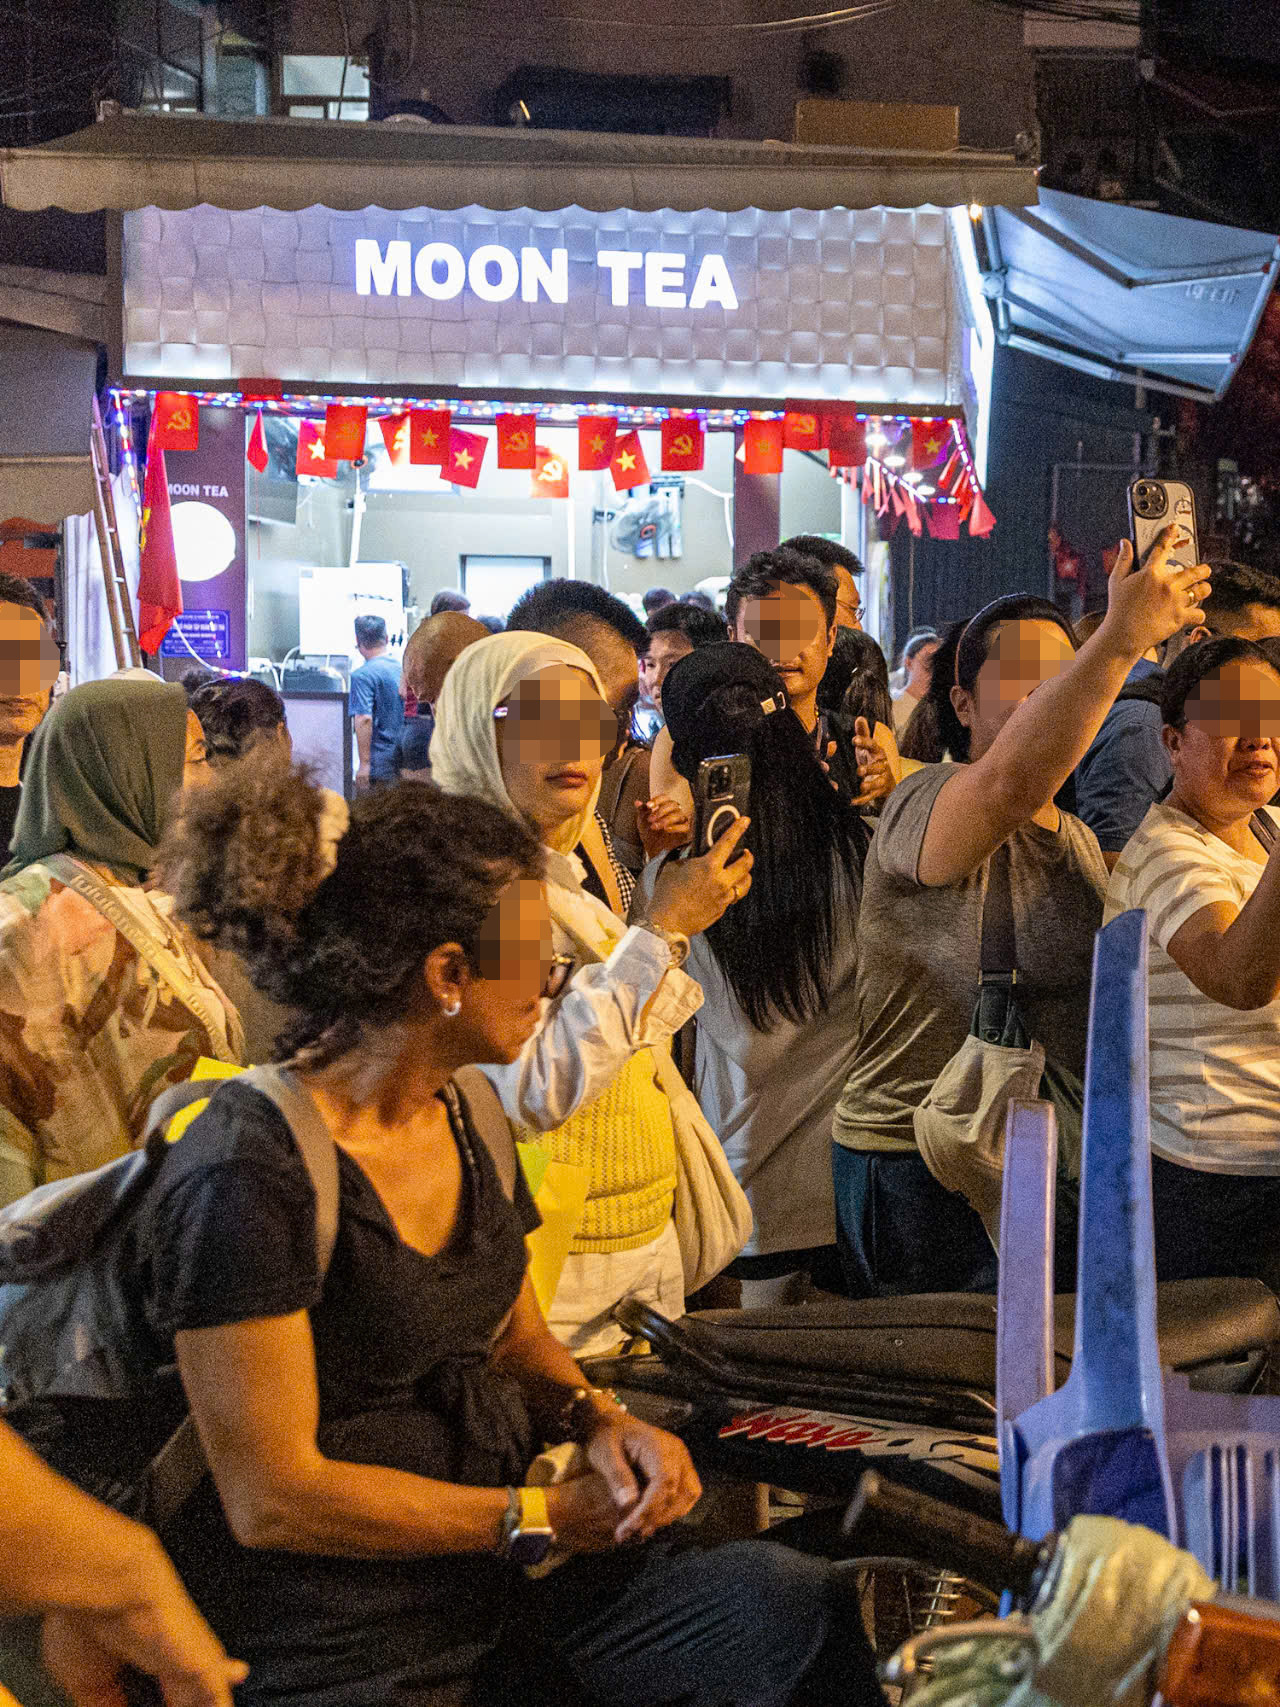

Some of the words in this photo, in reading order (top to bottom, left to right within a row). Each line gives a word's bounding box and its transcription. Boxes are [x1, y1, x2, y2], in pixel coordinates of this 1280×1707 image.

[355, 239, 568, 303] MOON
[597, 250, 739, 310] TEA
[203, 485, 229, 498] TEA
